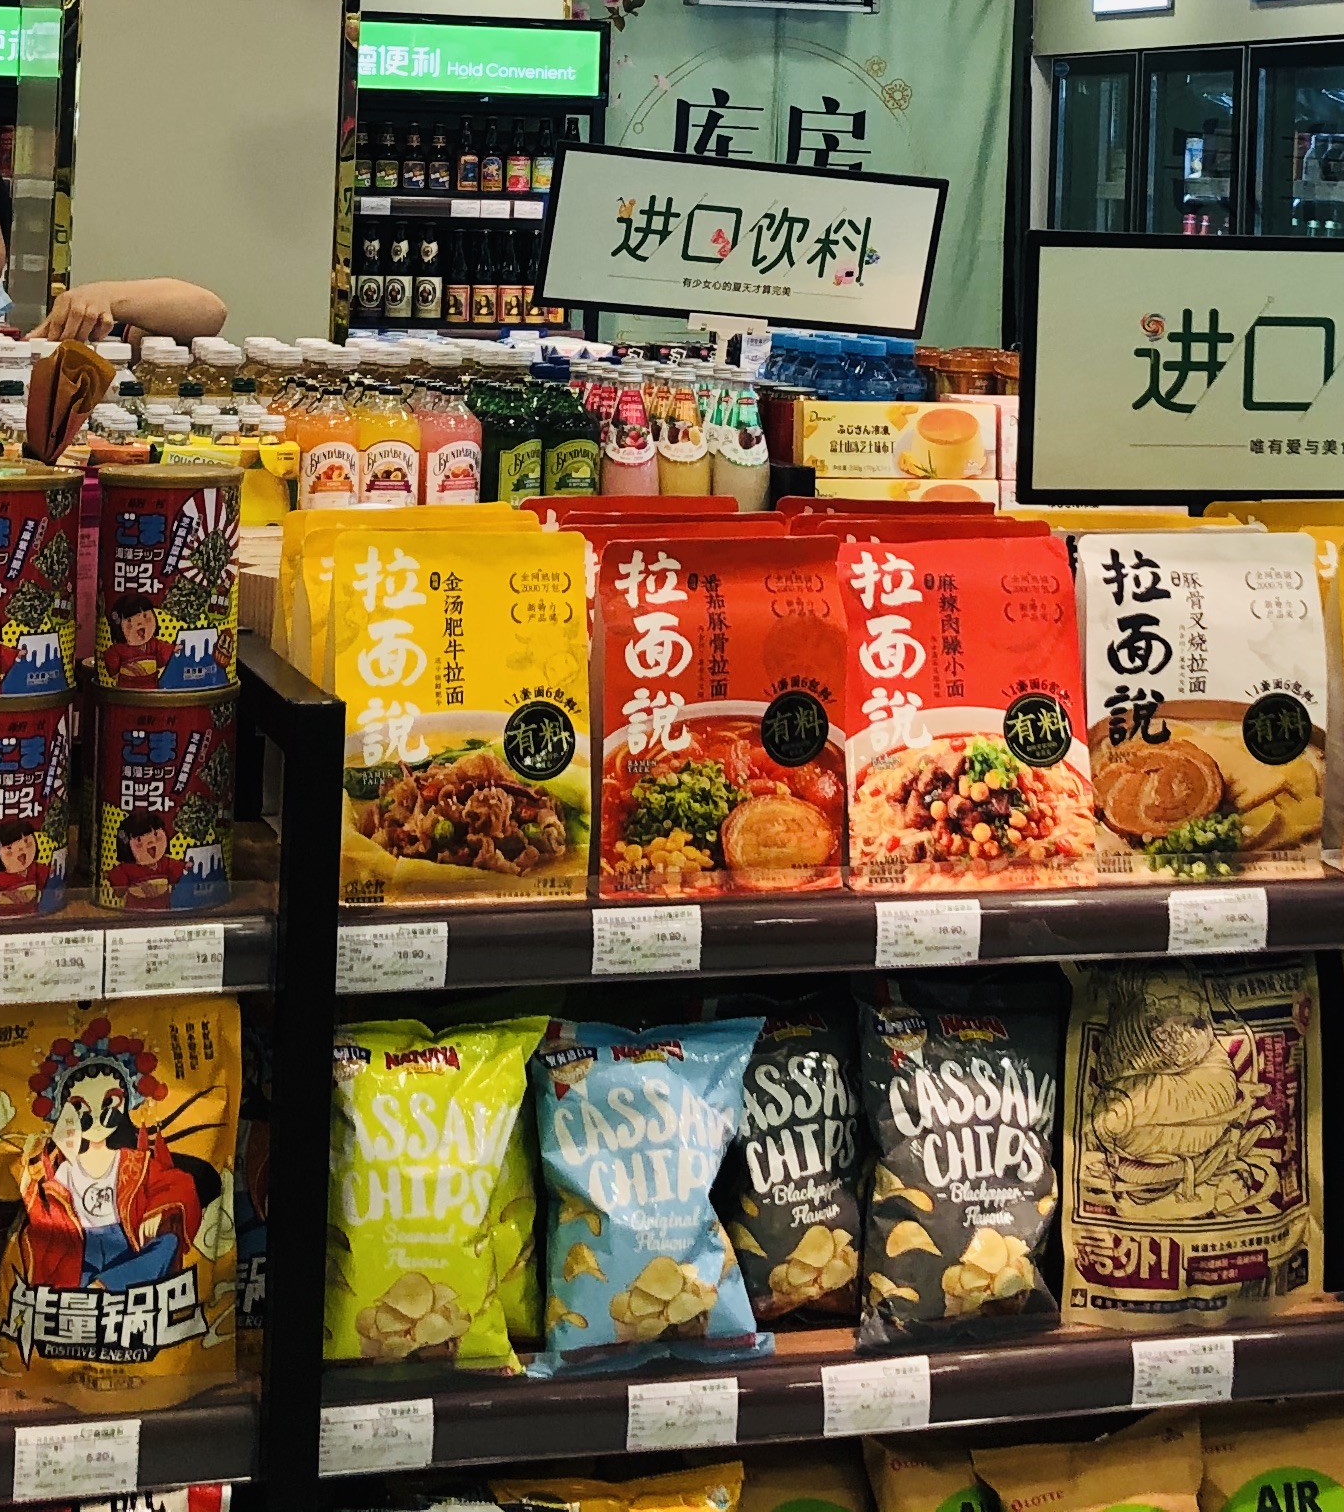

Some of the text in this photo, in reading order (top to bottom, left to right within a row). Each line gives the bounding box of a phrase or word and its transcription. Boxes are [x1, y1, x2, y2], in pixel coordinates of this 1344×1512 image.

[447, 61, 483, 77] Hold
[486, 63, 576, 81] Convenient
[611, 194, 872, 285] 进口饮料
[115, 513, 166, 547] ごま
[114, 561, 154, 578] ロック
[114, 577, 164, 594] ロースト
[508, 720, 570, 756] 有料
[1006, 708, 1068, 742] 有料
[122, 730, 177, 764] ごま
[121, 781, 164, 797] ロック
[121, 795, 174, 811] ロースト
[746, 1118, 857, 1194] CHIPS
[923, 1123, 1044, 1188] CHIPS
[342, 1166, 493, 1226] CHIPS
[588, 1147, 722, 1212] CHIP
[630, 1206, 701, 1238] Original
[1, 1271, 208, 1358] 能量锅巴
[44, 1344, 152, 1363] POSITIVE ENERGY
[1258, 1480, 1322, 1512] AIR
